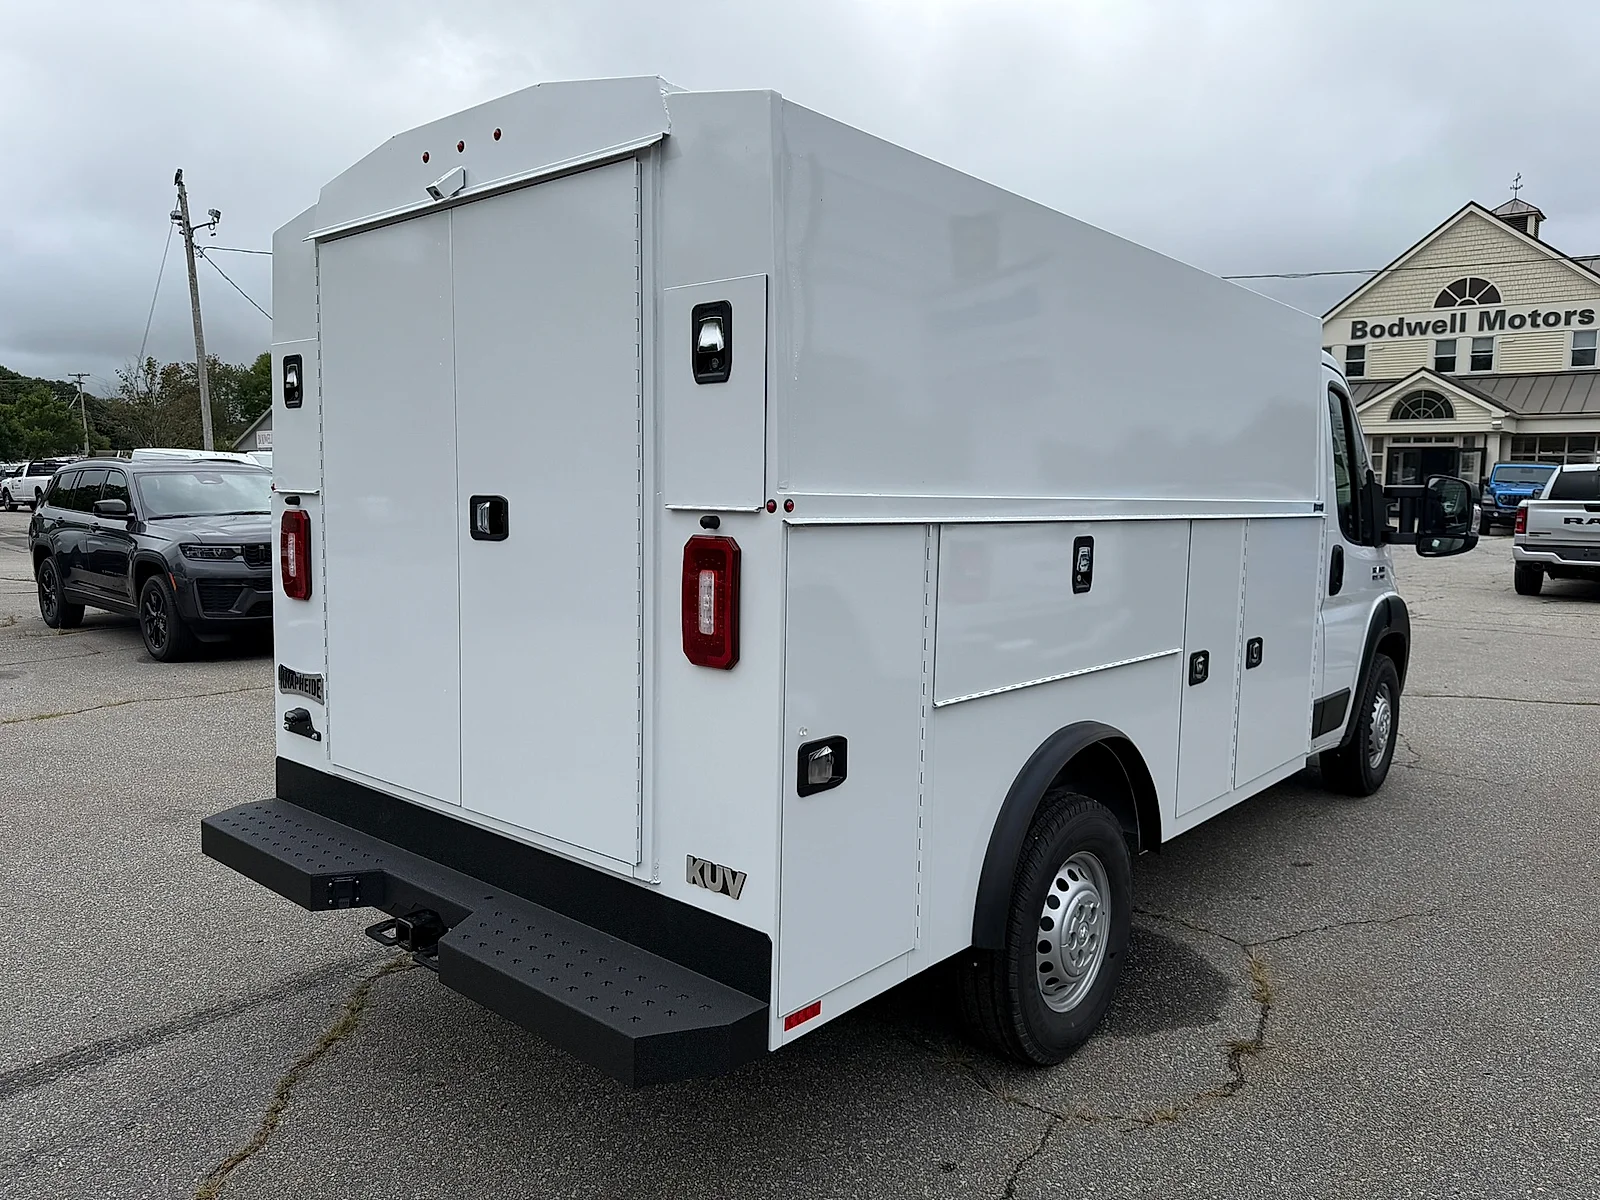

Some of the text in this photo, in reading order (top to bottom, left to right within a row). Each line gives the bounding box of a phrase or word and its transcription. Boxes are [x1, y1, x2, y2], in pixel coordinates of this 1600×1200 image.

[1351, 308, 1595, 340] Bodwell Motors
[687, 855, 747, 900] KUV
